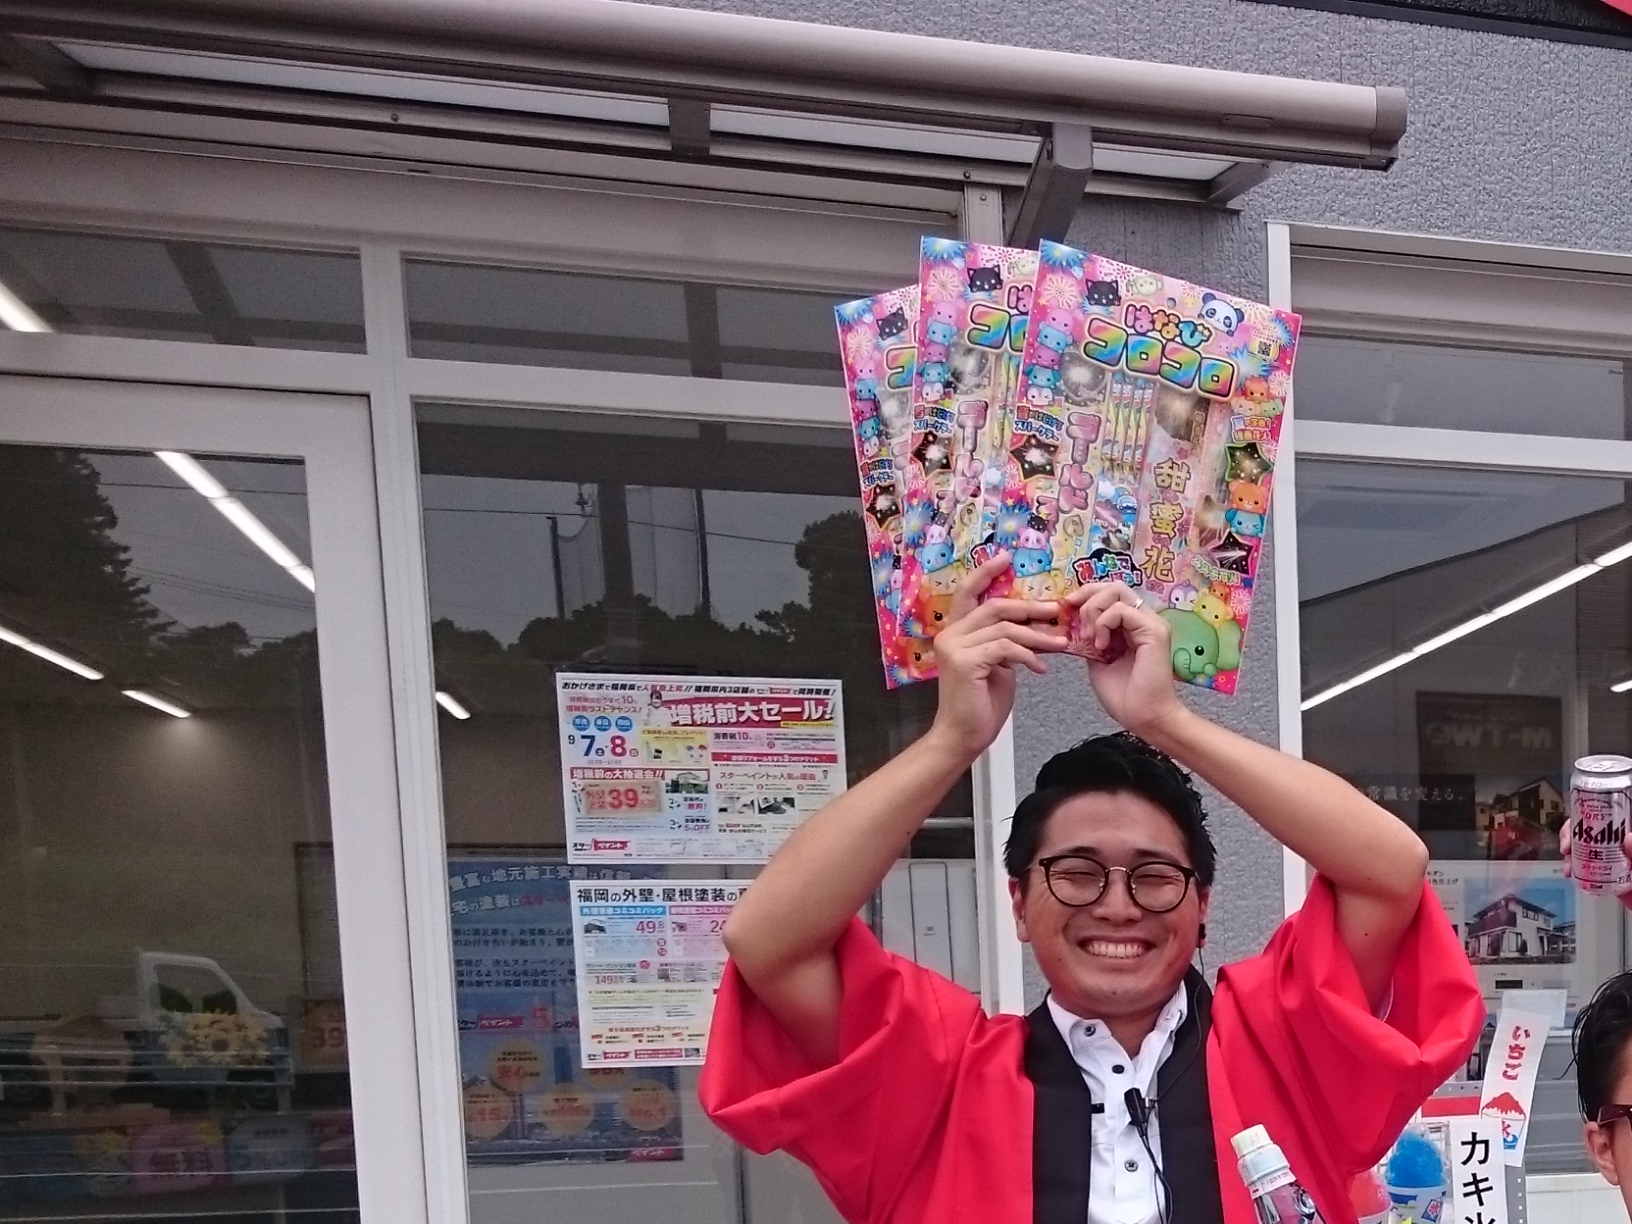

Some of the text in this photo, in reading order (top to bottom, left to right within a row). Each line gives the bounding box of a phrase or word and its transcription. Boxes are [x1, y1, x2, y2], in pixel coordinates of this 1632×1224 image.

[1124, 303, 1212, 348] はなび
[1084, 317, 1236, 398] コロコロ
[580, 735, 596, 756] 7
[610, 735, 627, 757] 8
[608, 788, 639, 810] 39
[1572, 818, 1626, 845] Asahi
[1588, 849, 1604, 860] 生
